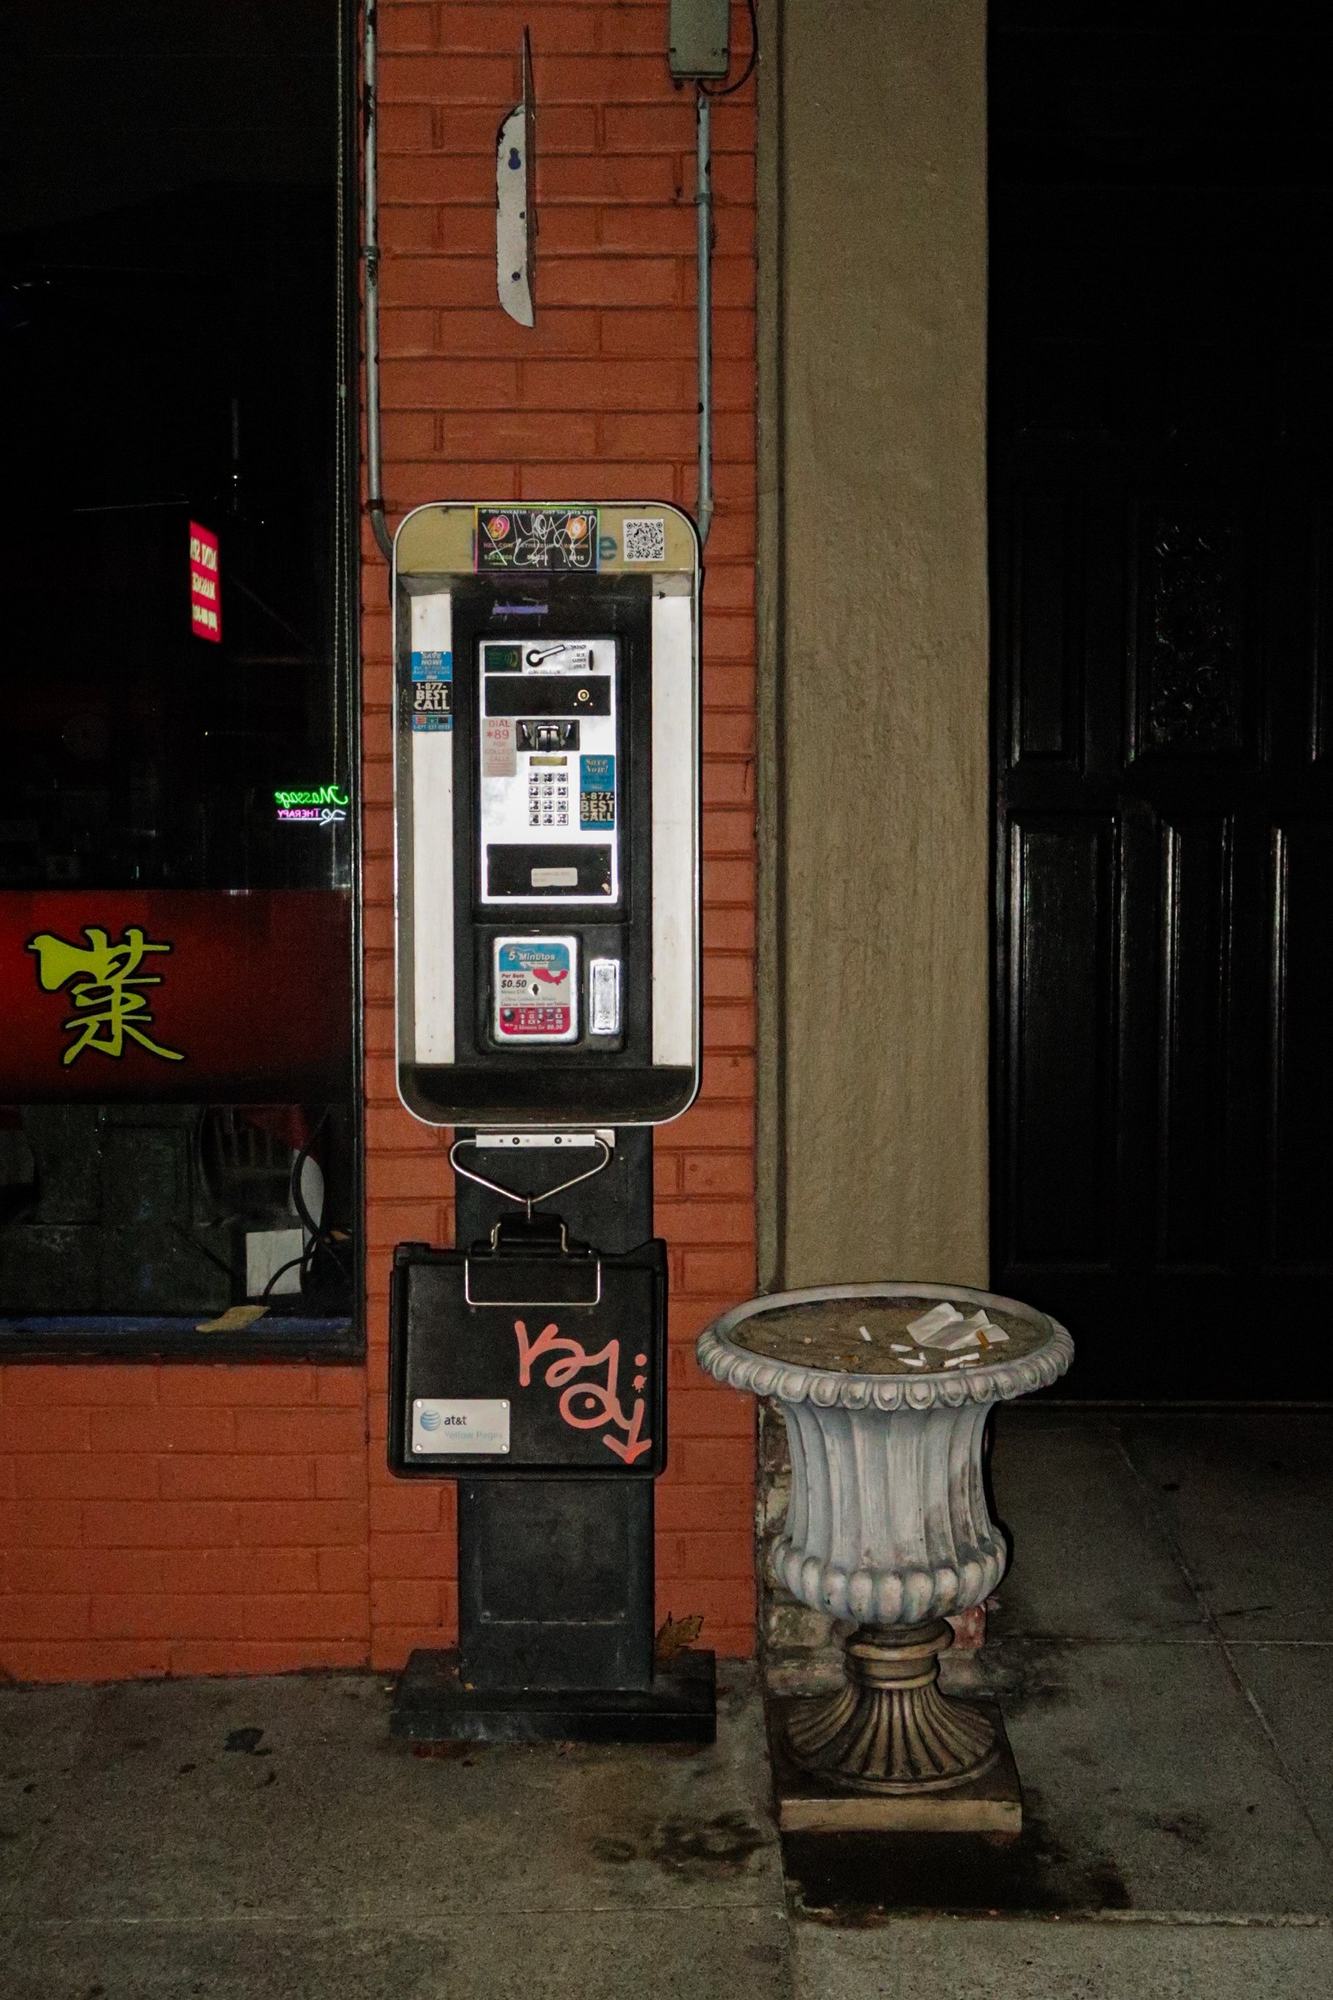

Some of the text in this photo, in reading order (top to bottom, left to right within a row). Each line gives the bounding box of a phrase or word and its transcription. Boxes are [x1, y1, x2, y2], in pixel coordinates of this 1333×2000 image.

[415, 690, 449, 700] BEST
[414, 700, 450, 710] CALL
[488, 720, 511, 728] DIAL
[580, 792, 614, 800] 1-877-
[580, 801, 614, 812] BEST
[580, 812, 614, 821] CALL
[508, 950, 556, 961] 5 Minutos
[501, 980, 527, 989] $0.50
[443, 1415, 468, 1426] at&t
